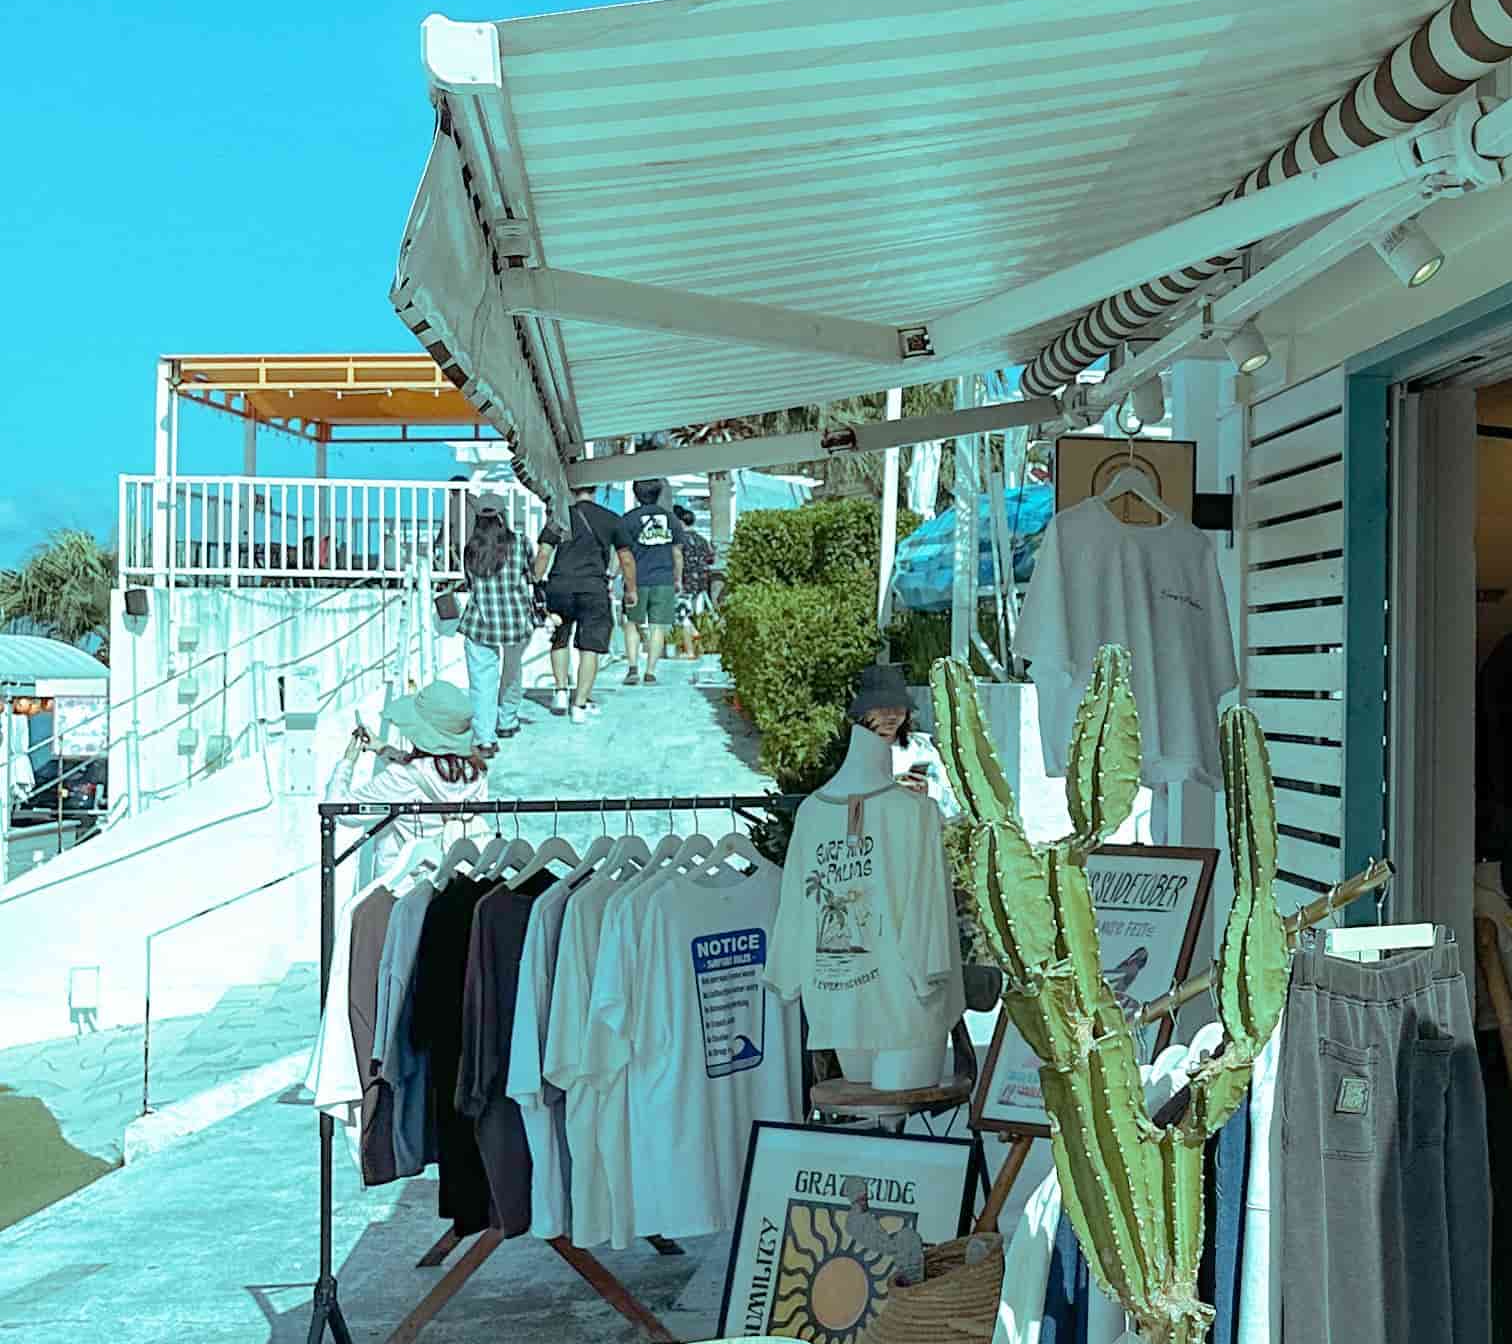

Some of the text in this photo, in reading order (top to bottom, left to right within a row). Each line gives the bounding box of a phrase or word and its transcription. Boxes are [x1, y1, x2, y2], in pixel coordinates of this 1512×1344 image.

[826, 858, 873, 885] PALMS
[696, 934, 760, 959] NOTICE
[795, 1169, 917, 1205] GRATTUDE
